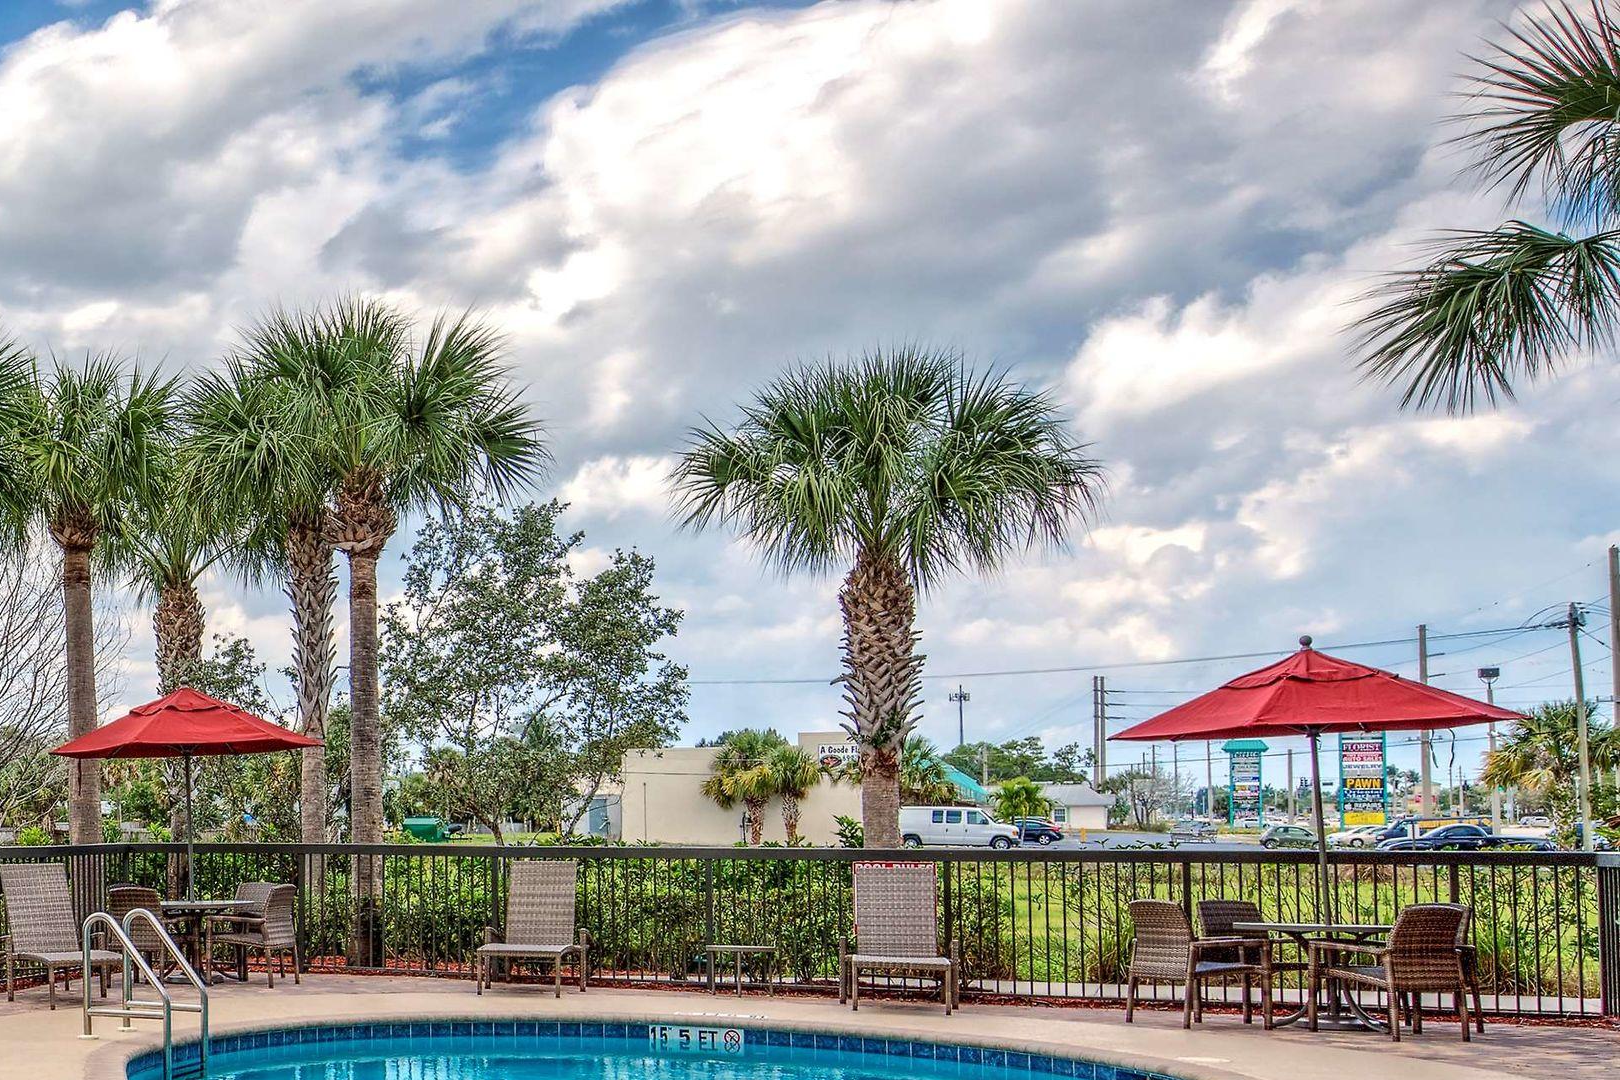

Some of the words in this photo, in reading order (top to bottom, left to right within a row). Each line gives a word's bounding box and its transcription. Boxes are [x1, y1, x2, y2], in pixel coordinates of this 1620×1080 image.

[820, 746, 826, 754] A
[827, 746, 849, 754] Goode
[1342, 743, 1381, 751] FLORIST
[1346, 778, 1381, 789] PAWN
